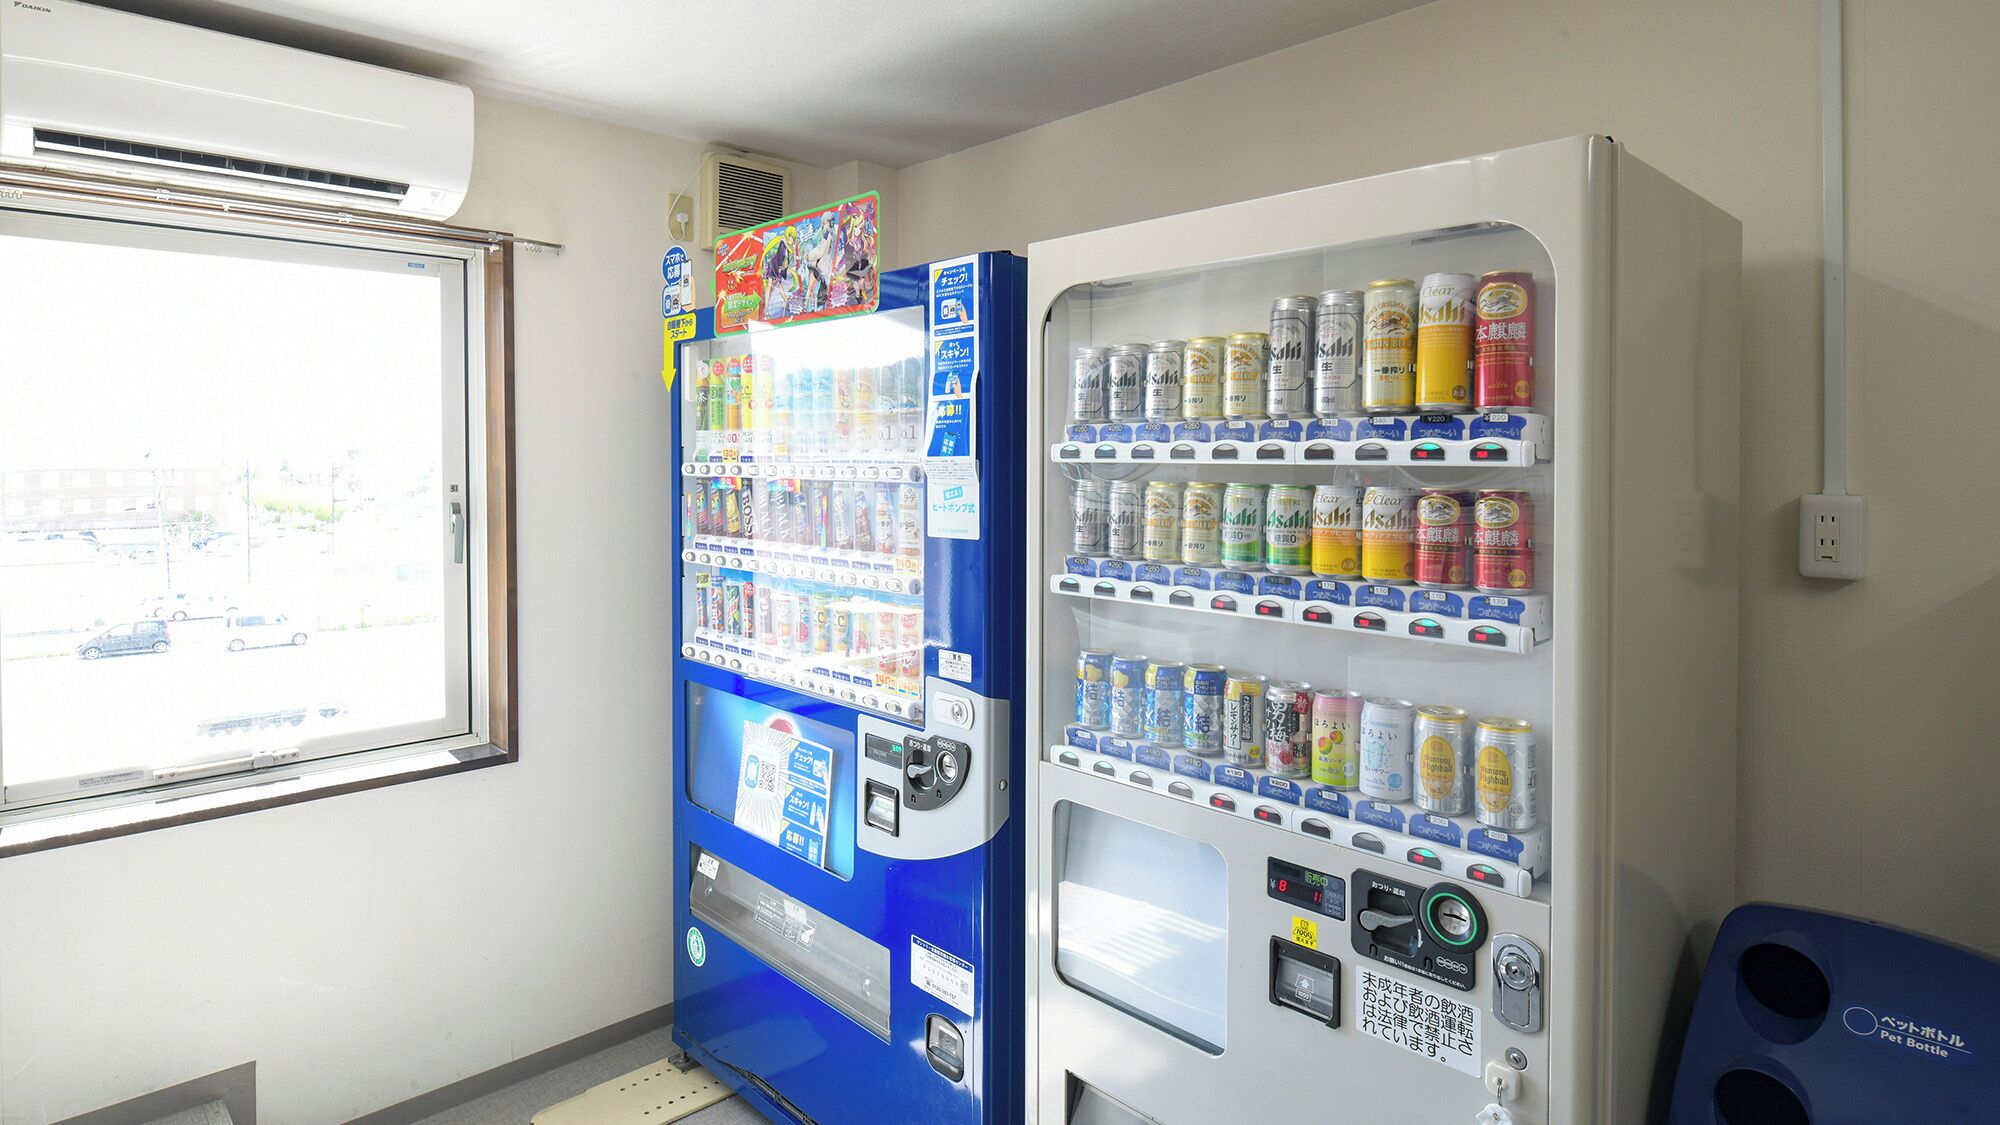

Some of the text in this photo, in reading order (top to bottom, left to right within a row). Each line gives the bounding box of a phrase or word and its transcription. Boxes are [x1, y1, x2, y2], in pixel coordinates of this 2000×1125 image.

[22, 4, 52, 13] DAIKIN
[664, 253, 685, 266] スマホで
[1423, 286, 1455, 298] Clear
[671, 330, 688, 340] スタート
[1476, 322, 1526, 342] 本麒麟
[1270, 341, 1302, 361] sahi
[1272, 365, 1283, 375] 生
[1322, 362, 1333, 372] 生
[1374, 366, 1405, 375] 一番搾り
[1113, 391, 1122, 399] 生
[1153, 388, 1163, 397] 生
[1373, 494, 1405, 506] Clear
[742, 494, 754, 535] BOSS
[1267, 510, 1311, 529] Asahi
[1112, 528, 1121, 536] 生
[1416, 526, 1460, 543] 本麒麟
[1474, 530, 1520, 547] 本麒麟
[1196, 714, 1211, 733] 結
[1230, 703, 1240, 747] レモンサワー
[1423, 754, 1451, 765] Suntory
[1422, 762, 1453, 774] Highball
[1480, 766, 1507, 778] Suntory
[1271, 779, 1289, 788] ¥200
[1479, 774, 1509, 787] Highball
[1278, 879, 1287, 892] 8
[1296, 928, 1313, 939] 1000
[1295, 988, 1312, 1001] 1000
[1362, 971, 1474, 1021] 未成年者の飲酒
[1362, 987, 1474, 1041] および飲酒運転
[1362, 1003, 1474, 1056] は法律で禁止さ
[1881, 1016, 1966, 1047] ペットボトル
[1362, 1016, 1447, 1063] れています。
[1880, 1030, 1949, 1059] Pet Bottle
